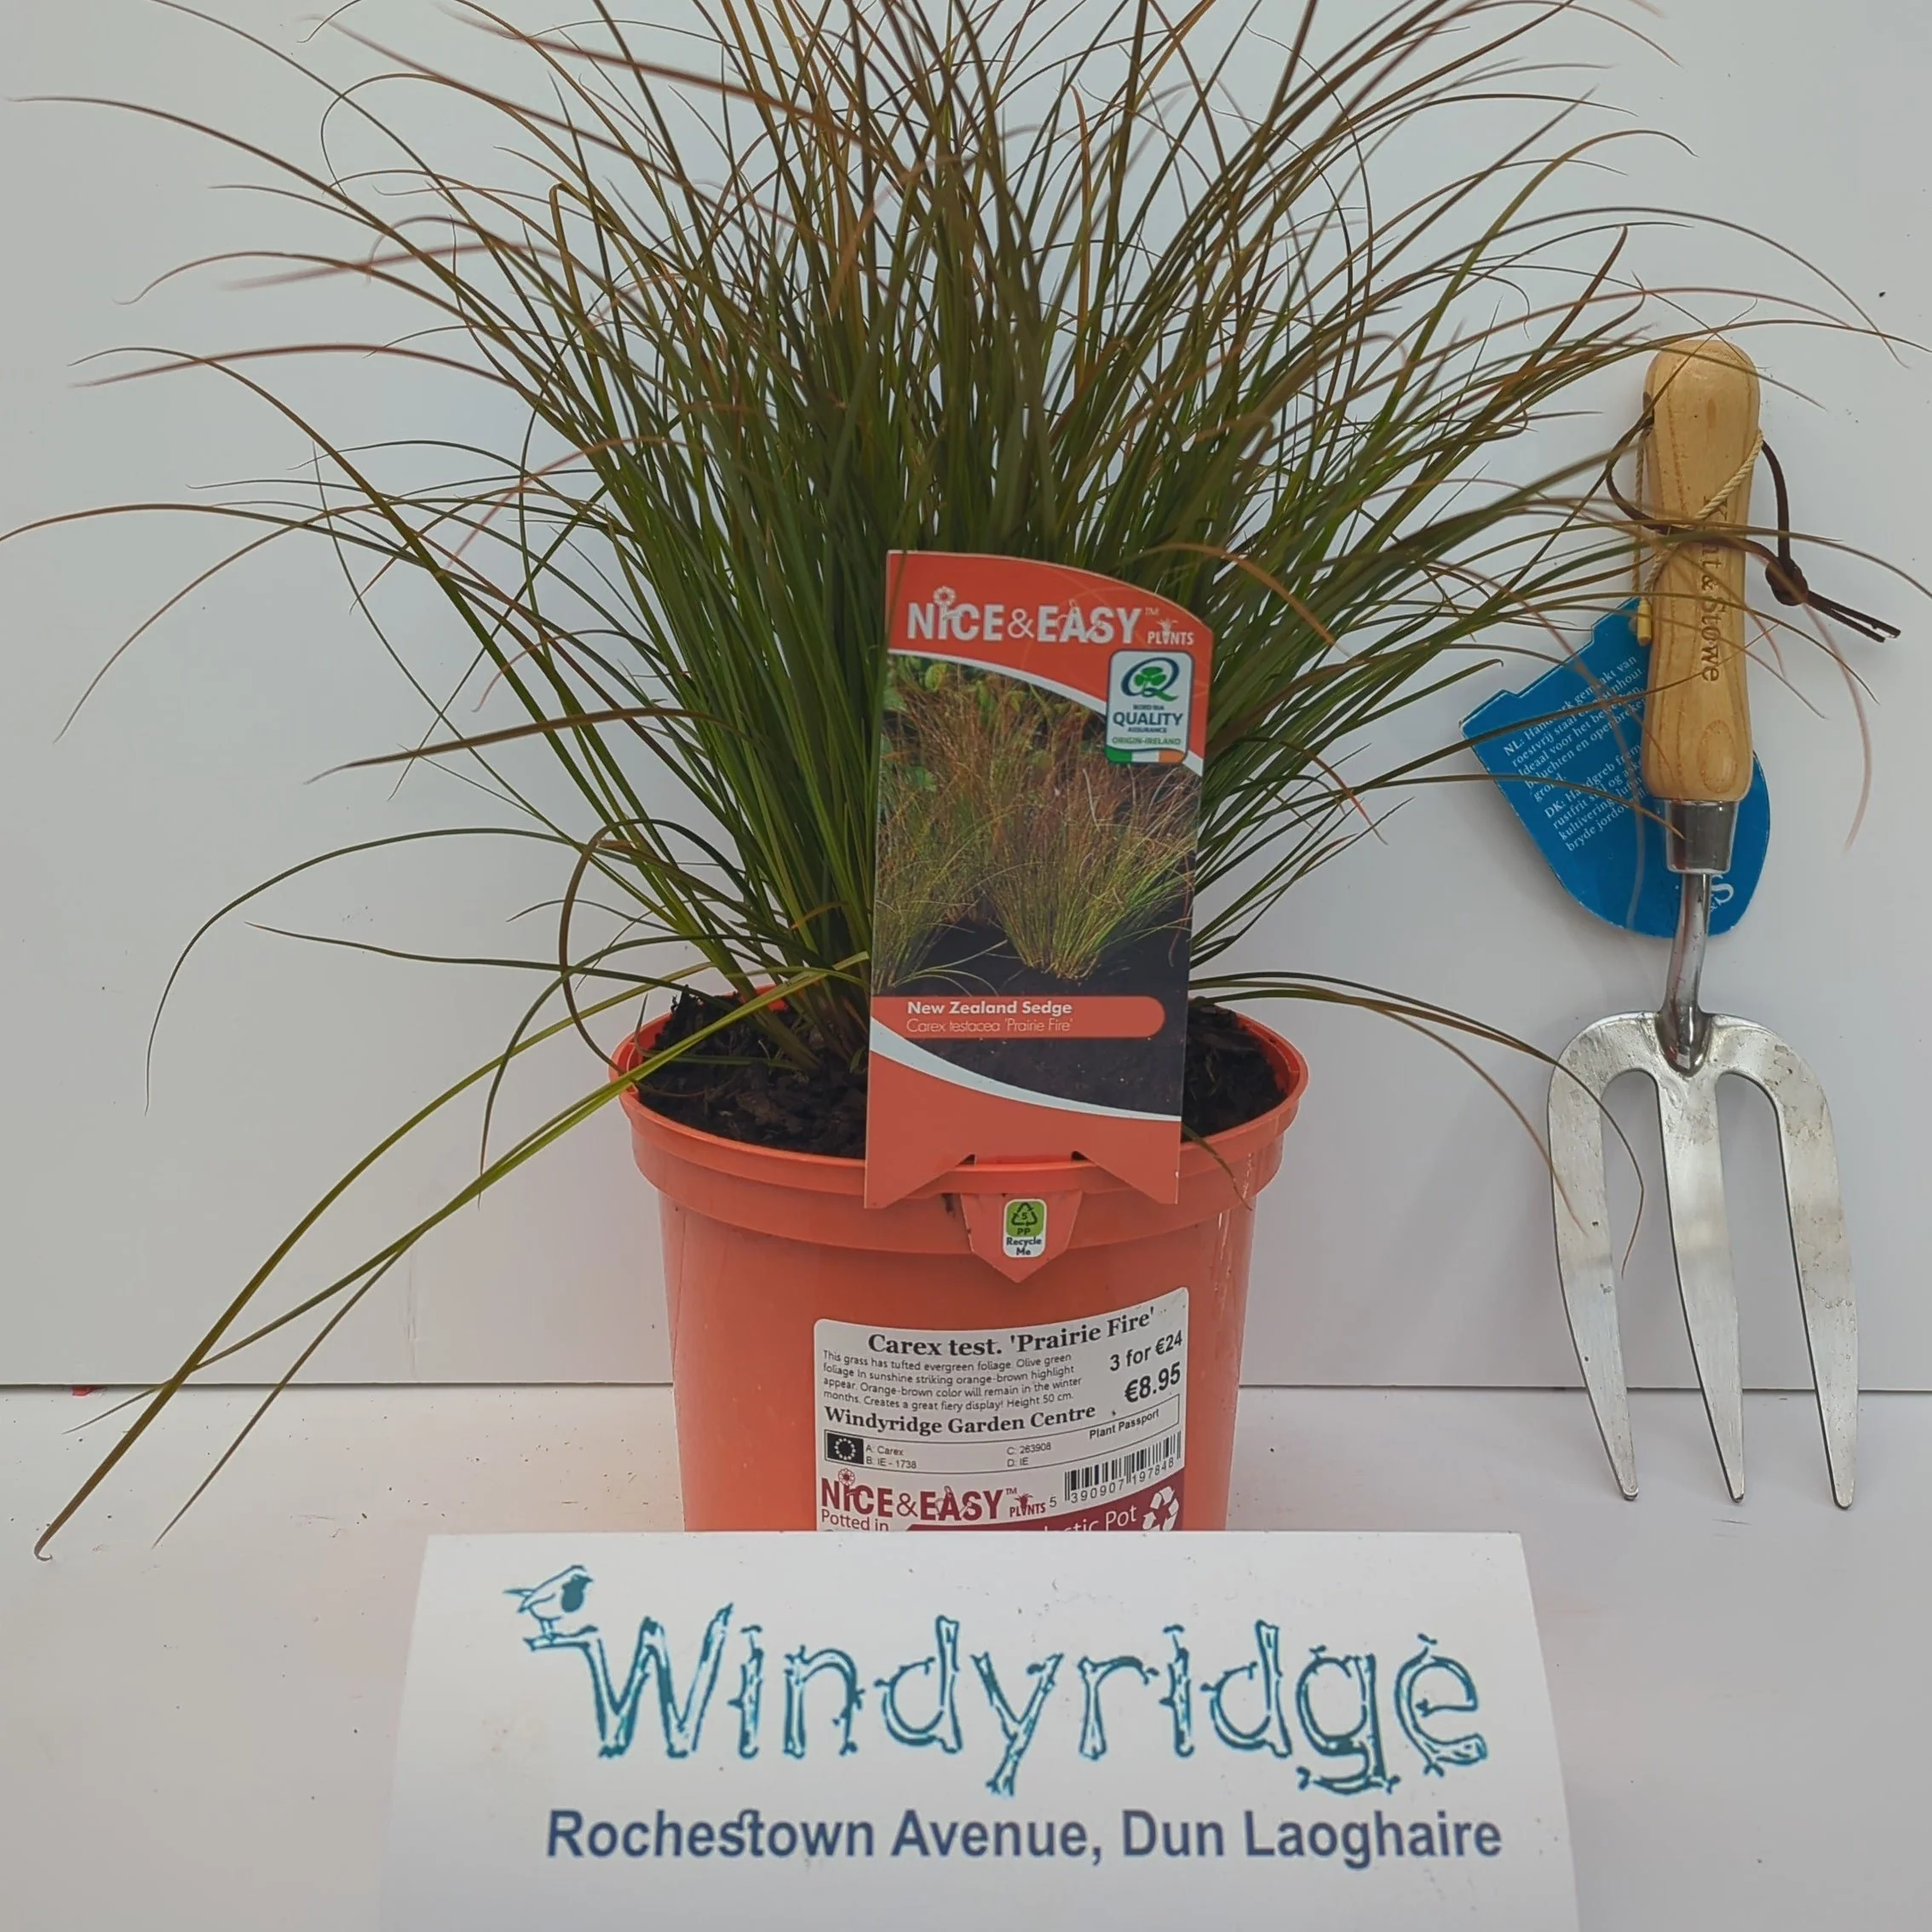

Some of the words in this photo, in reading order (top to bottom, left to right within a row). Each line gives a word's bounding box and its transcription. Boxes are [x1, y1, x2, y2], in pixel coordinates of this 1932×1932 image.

[1113, 711, 1183, 727] QUALITY
[1503, 735, 1526, 756] NL:
[1549, 733, 1574, 755] voor
[1571, 718, 1591, 737] het
[1523, 747, 1576, 789] bluchten
[1607, 774, 1624, 790] og
[1543, 797, 1566, 818] DK:
[1564, 823, 1598, 853] bryde
[907, 1001, 945, 1014] New
[949, 1001, 1017, 1014] Zealand
[1022, 1001, 1072, 1016] Sedge
[906, 1018, 946, 1032] Carex
[949, 1019, 1000, 1032] testacea
[1006, 1236, 1042, 1249] Recycle
[1016, 1246, 1032, 1256] Me
[868, 1334, 942, 1355] Carex
[948, 1338, 1002, 1356] test.
[1010, 1324, 1101, 1353] 'Prairie
[1107, 1306, 1154, 1337] Fire'
[823, 1349, 841, 1361] This
[844, 1356, 868, 1366] grass
[871, 1358, 888, 1368] has
[891, 1360, 920, 1370] tufted
[924, 1364, 974, 1373] evergreen
[1016, 1358, 1041, 1367] Olive
[1044, 1354, 1072, 1367] green
[1110, 1354, 1120, 1371] 3
[1126, 1347, 1151, 1366] for
[1155, 1330, 1182, 1355] €24
[823, 1363, 854, 1377] foliage
[858, 1369, 866, 1377] in
[870, 1372, 913, 1383] sunshine
[916, 1375, 953, 1387] striking
[956, 1373, 1027, 1386] orange-brown
[1031, 1366, 1074, 1380] highlight
[1124, 1361, 1181, 1403] €8.95
[860, 1382, 933, 1397] Orange-brown
[936, 1388, 962, 1397] color
[964, 1387, 981, 1396] will
[985, 1385, 1019, 1395] remain
[1022, 1384, 1031, 1394] in
[1034, 1383, 1049, 1392] the
[1052, 1377, 1082, 1389] winter
[823, 1390, 861, 1404] months.
[864, 1396, 900, 1407] Creates
[911, 1402, 938, 1412] great
[941, 1400, 963, 1413] fiery
[1007, 1396, 1039, 1408] Height
[1043, 1394, 1055, 1404] 50
[825, 1406, 942, 1436] Windyridge
[948, 1416, 1026, 1434] Garden
[1031, 1406, 1095, 1426] Centre
[1090, 1423, 1116, 1439] Plant
[1118, 1409, 1159, 1432] Passport
[877, 1446, 904, 1456] Carex
[1020, 1457, 1029, 1465] IE
[877, 1458, 887, 1466] IE
[896, 1459, 917, 1469] 1738
[821, 1509, 870, 1531] Potted
[875, 1518, 888, 1531] in
[1106, 1504, 1137, 1531] Pot
[526, 1604, 1488, 1796] Windyridge
[547, 1809, 874, 1860] Rochestown
[892, 1809, 1102, 1866] Avenue,
[1124, 1809, 1223, 1858] Dun
[1245, 1809, 1501, 1869] Laoghaire
